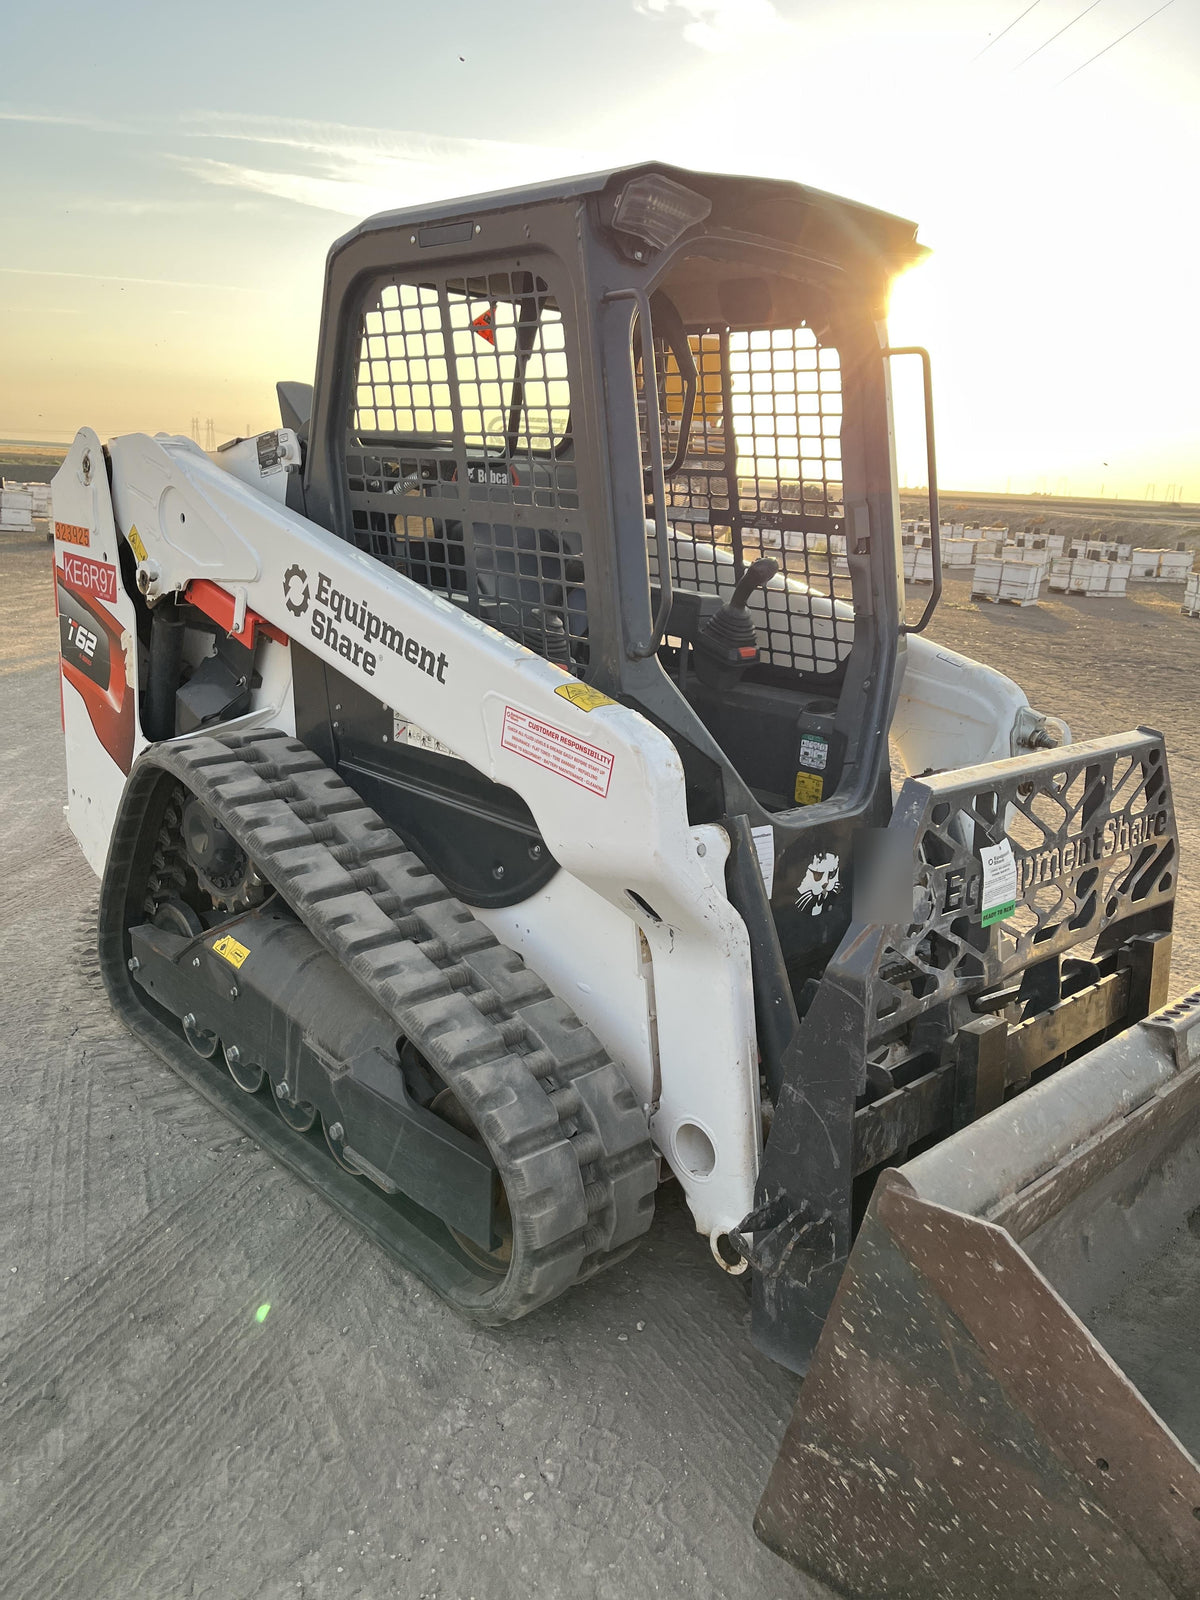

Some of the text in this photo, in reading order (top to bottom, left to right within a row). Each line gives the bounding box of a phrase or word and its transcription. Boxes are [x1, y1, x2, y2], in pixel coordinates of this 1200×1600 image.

[477, 468, 511, 485] Bbca
[64, 557, 115, 595] KE6R97
[315, 572, 449, 685] Equipment
[528, 721, 612, 766] CUSTOMER RESPONSIBILITY
[982, 910, 997, 922] READY
[997, 908, 1003, 916] TO
